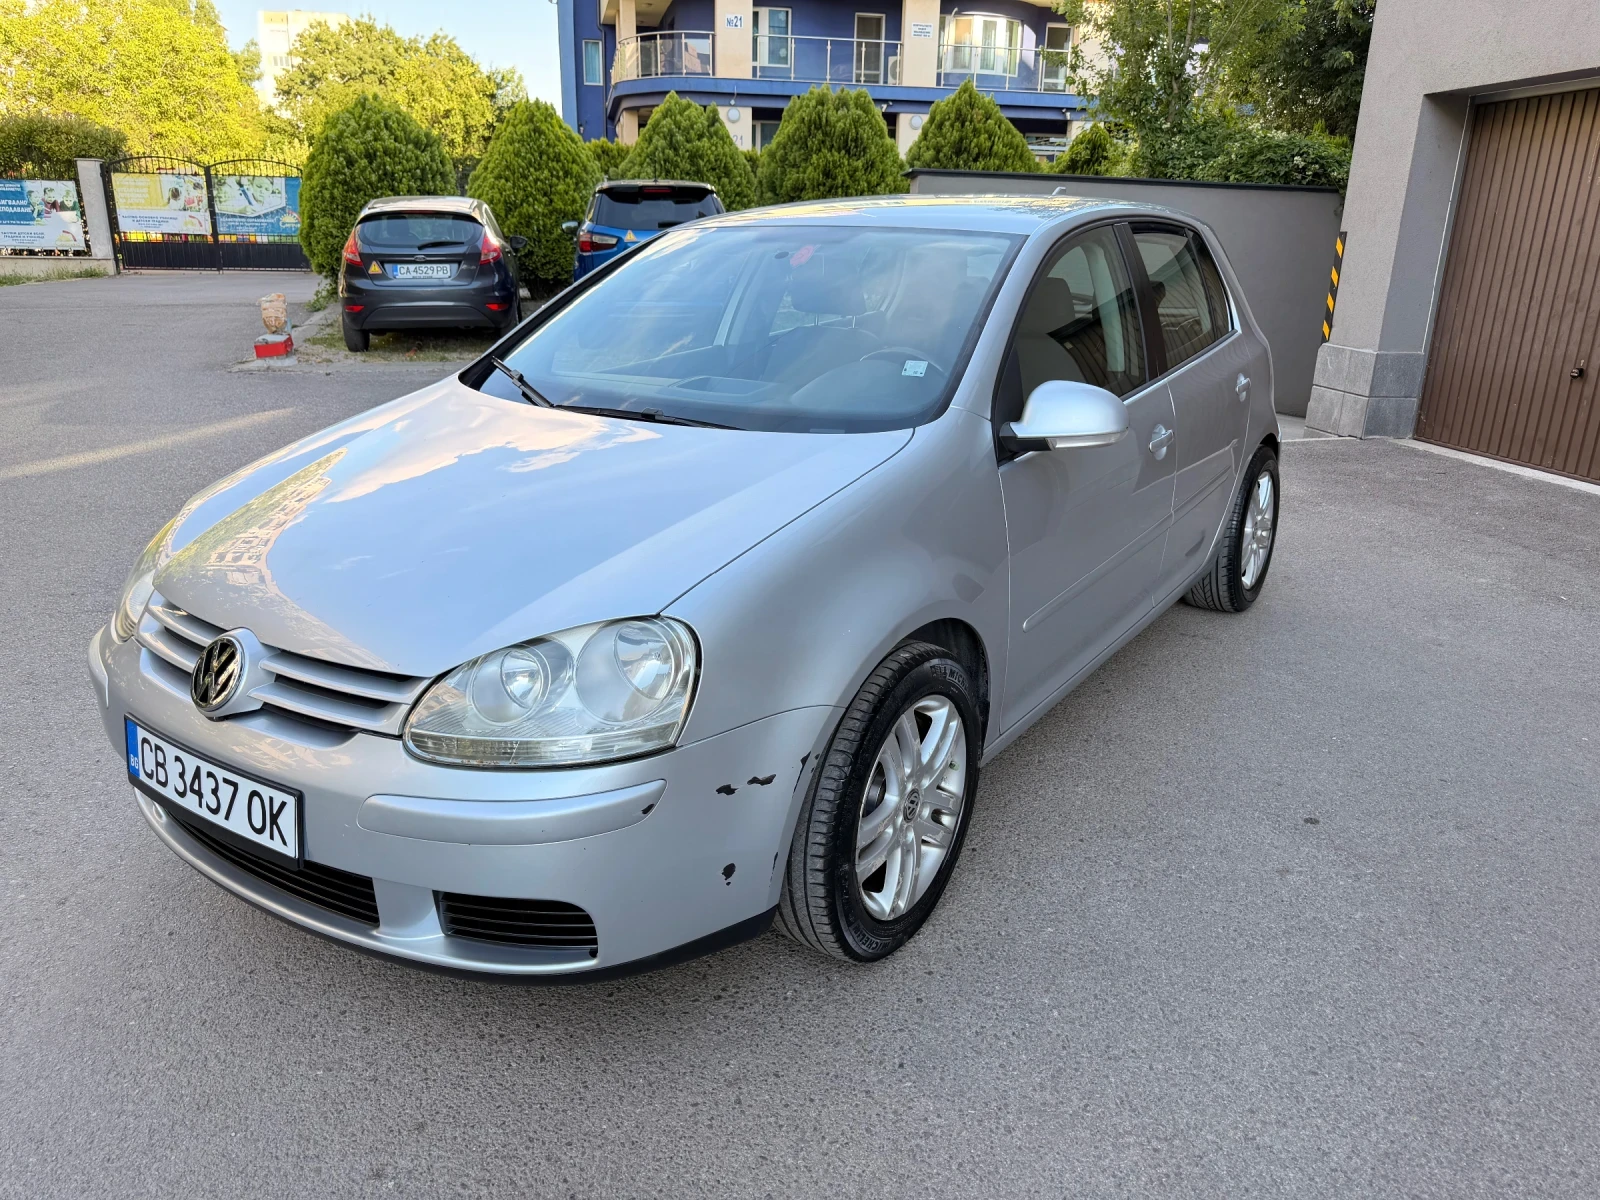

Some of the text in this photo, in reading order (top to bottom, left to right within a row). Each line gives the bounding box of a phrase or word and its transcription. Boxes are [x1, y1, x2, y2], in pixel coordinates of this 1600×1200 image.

[399, 265, 449, 275] CA 4529 PB
[130, 756, 139, 770] BG
[140, 736, 289, 847] CB 3437 OK
